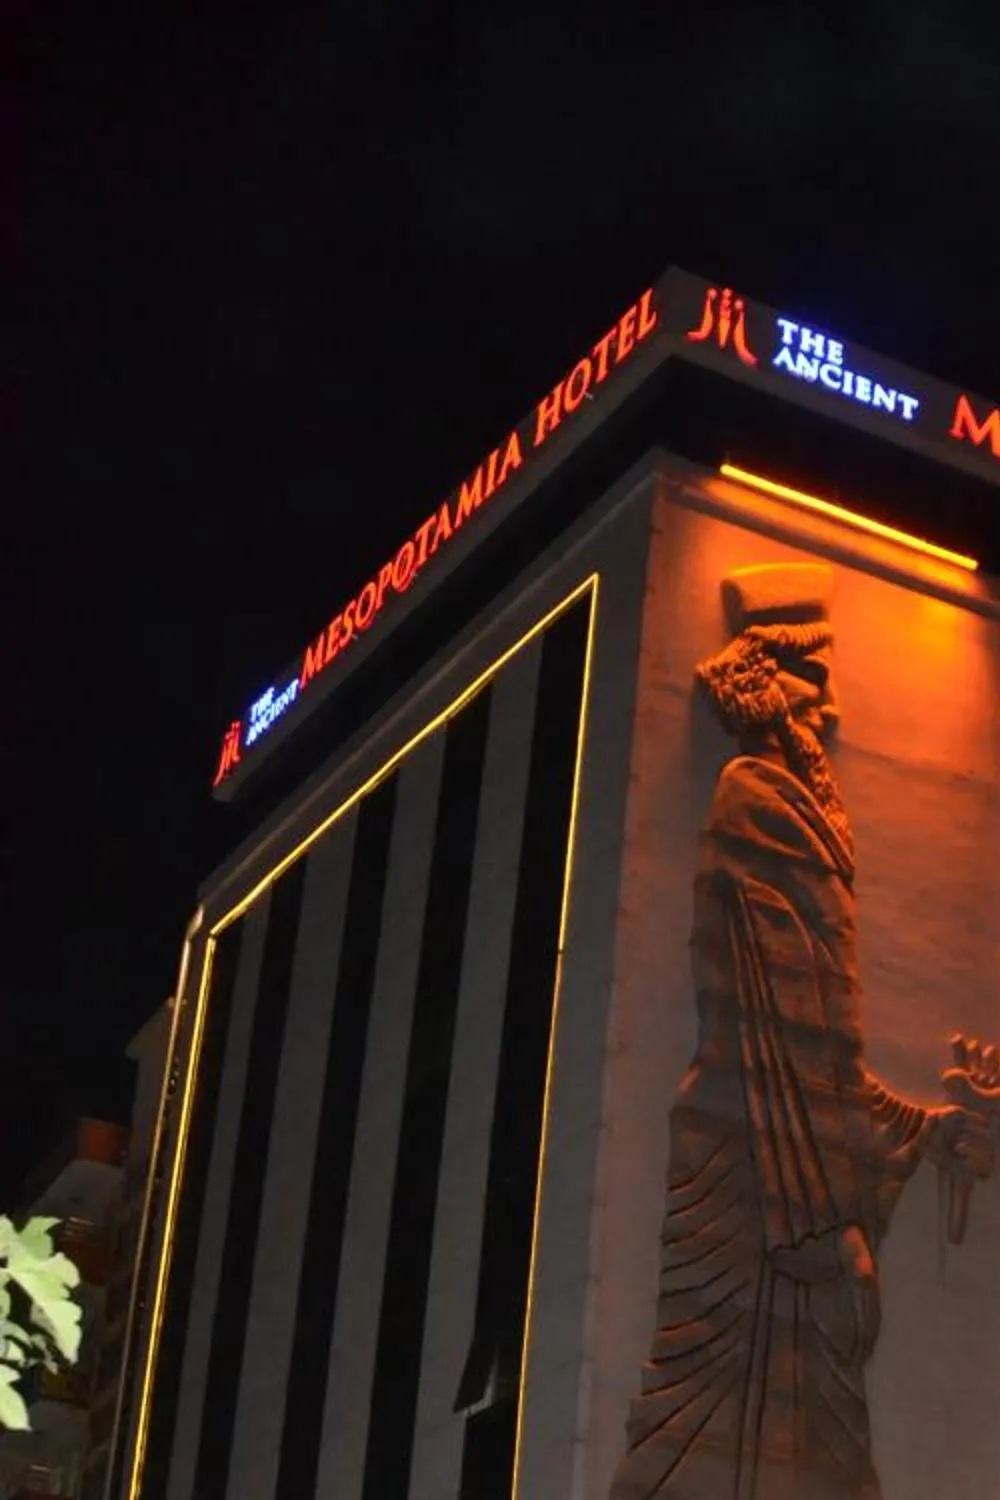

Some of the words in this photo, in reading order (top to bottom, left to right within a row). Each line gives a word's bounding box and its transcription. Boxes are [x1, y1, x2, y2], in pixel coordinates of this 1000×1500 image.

[777, 318, 844, 366] THE
[773, 346, 919, 420] ANCIENT
[301, 431, 524, 689] MESOPOTAMIA
[534, 287, 657, 446] HOTEL
